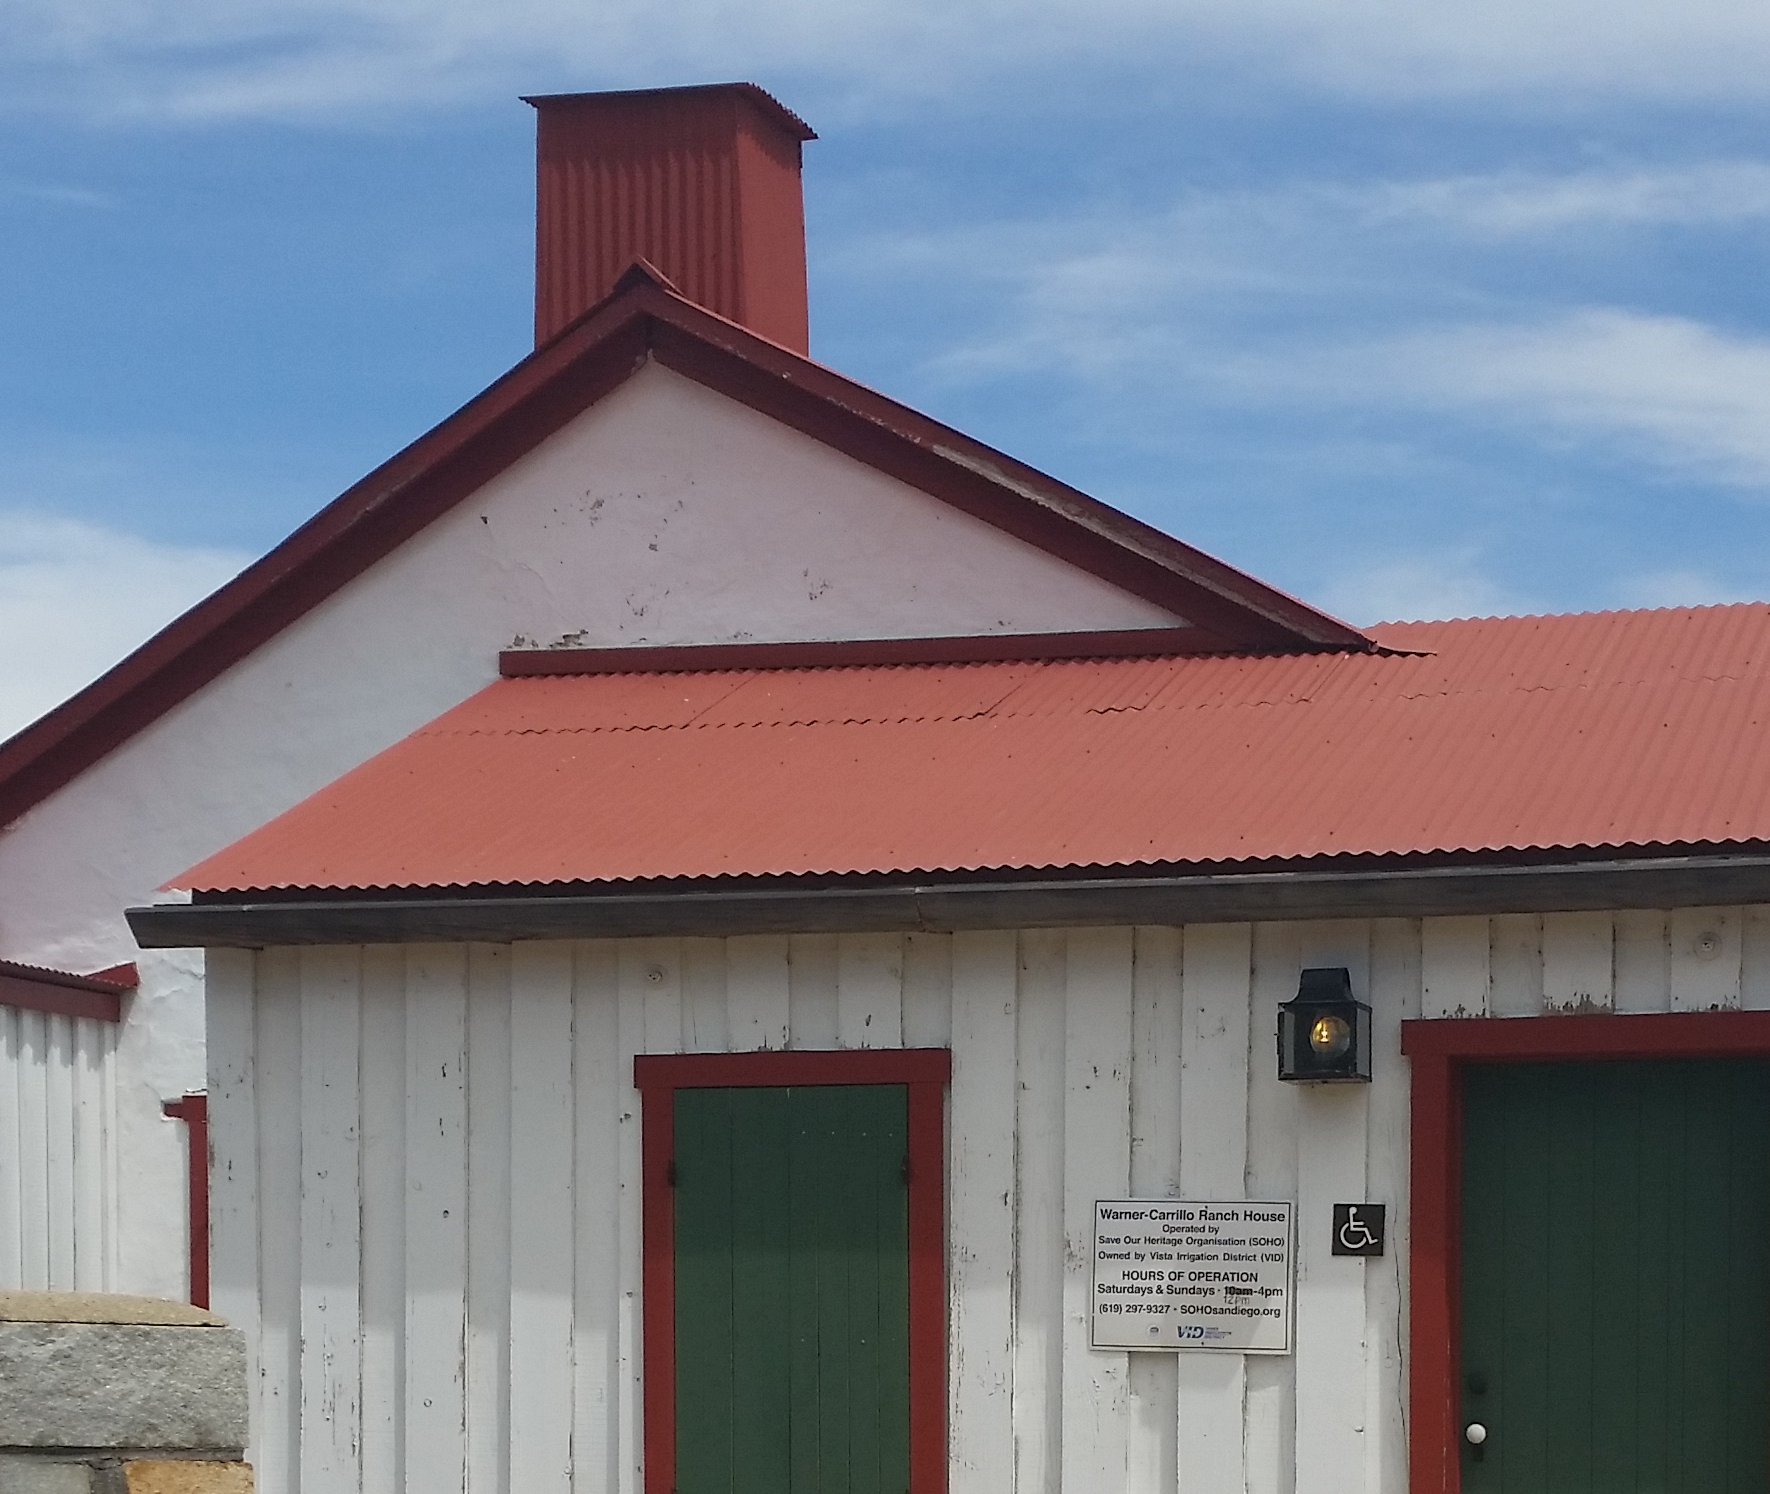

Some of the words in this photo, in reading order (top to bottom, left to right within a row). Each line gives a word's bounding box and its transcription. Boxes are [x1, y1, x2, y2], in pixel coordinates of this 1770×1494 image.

[1100, 1208, 1195, 1221] Warner-Carrillo
[1199, 1209, 1239, 1221] Ranch
[1243, 1210, 1286, 1222] House
[1162, 1224, 1206, 1234] Operated
[1208, 1225, 1220, 1235] by
[1098, 1235, 1121, 1244] Save
[1123, 1235, 1141, 1244] Our
[1144, 1236, 1183, 1246] Heritage
[1185, 1236, 1246, 1247] Organisation
[1249, 1237, 1285, 1247] (SOHO)
[1098, 1250, 1131, 1260] Owned
[1134, 1251, 1146, 1262] by
[1150, 1251, 1173, 1260] Vista
[1176, 1252, 1219, 1262] Irrigation
[1223, 1252, 1257, 1262] District
[1260, 1253, 1284, 1263] (VID)
[1122, 1270, 1165, 1281] HOURS
[1167, 1271, 1185, 1281] OF
[1188, 1271, 1258, 1282] OPERATION
[1097, 1283, 1153, 1297] Saturdays
[1155, 1284, 1164, 1295] &
[1166, 1284, 1215, 1298] Sundays
[1099, 1303, 1123, 1315] (619)
[1125, 1304, 1171, 1314] 297-9327
[1180, 1304, 1281, 1318] SOHOsandiego.org
